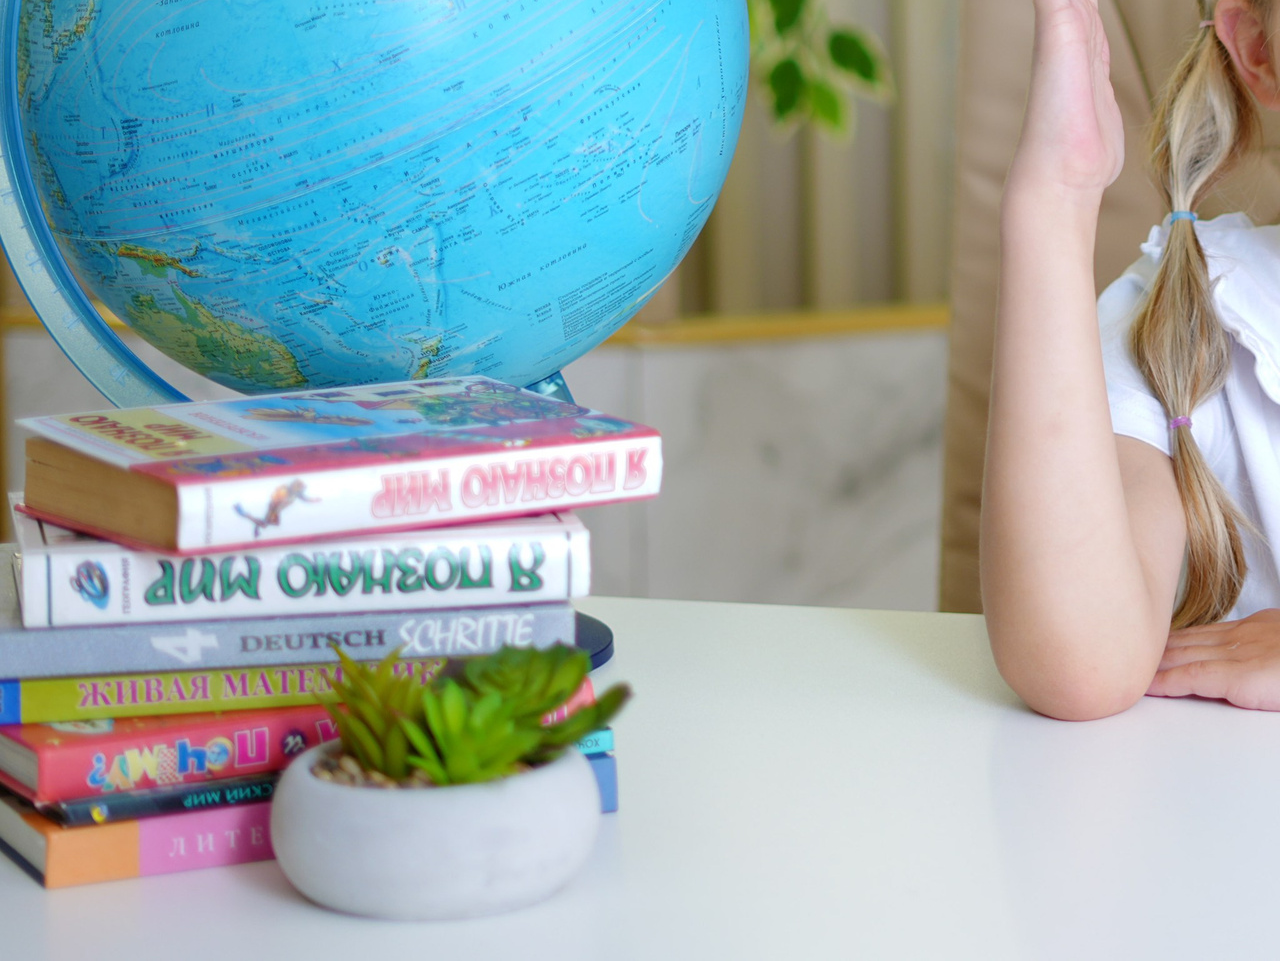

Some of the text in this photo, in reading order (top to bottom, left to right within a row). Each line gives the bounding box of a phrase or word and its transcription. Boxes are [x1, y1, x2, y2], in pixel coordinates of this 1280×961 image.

[155, 20, 200, 39] котловина
[539, 242, 588, 272] котловина
[371, 448, 649, 519] Я ПОЗНАЮ МИР
[144, 543, 547, 608] Я ПОЗНАЮ МИР
[240, 628, 387, 653] DEUTSCH
[400, 613, 535, 655] SCHRITTE
[78, 674, 211, 708] ЖИВАЯ
[182, 782, 275, 809] СКИЙ МИР
[168, 824, 266, 859] ЛИТЕ
